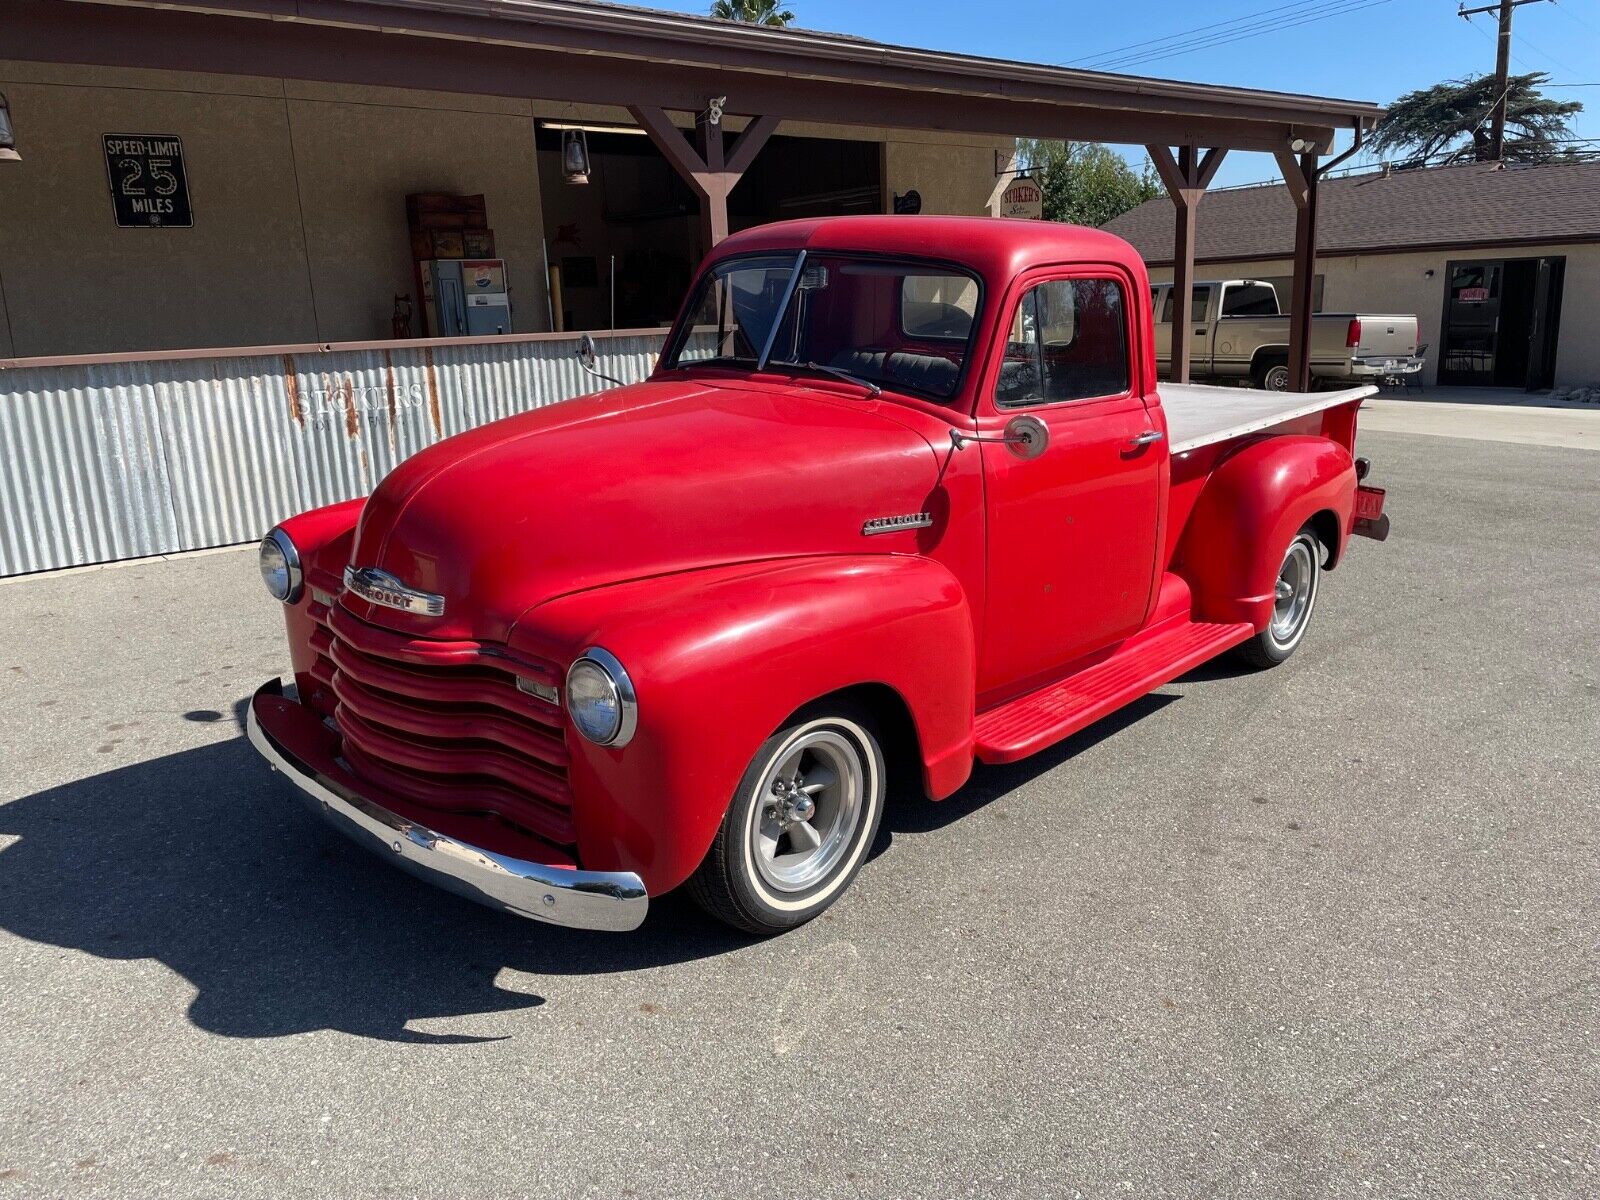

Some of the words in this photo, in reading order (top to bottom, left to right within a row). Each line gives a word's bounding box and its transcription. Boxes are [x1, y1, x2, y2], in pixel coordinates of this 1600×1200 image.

[119, 159, 178, 195] 25
[1004, 186, 1040, 203] STOKER'S
[132, 198, 174, 213] MILES
[864, 512, 931, 529] CHEVROLET
